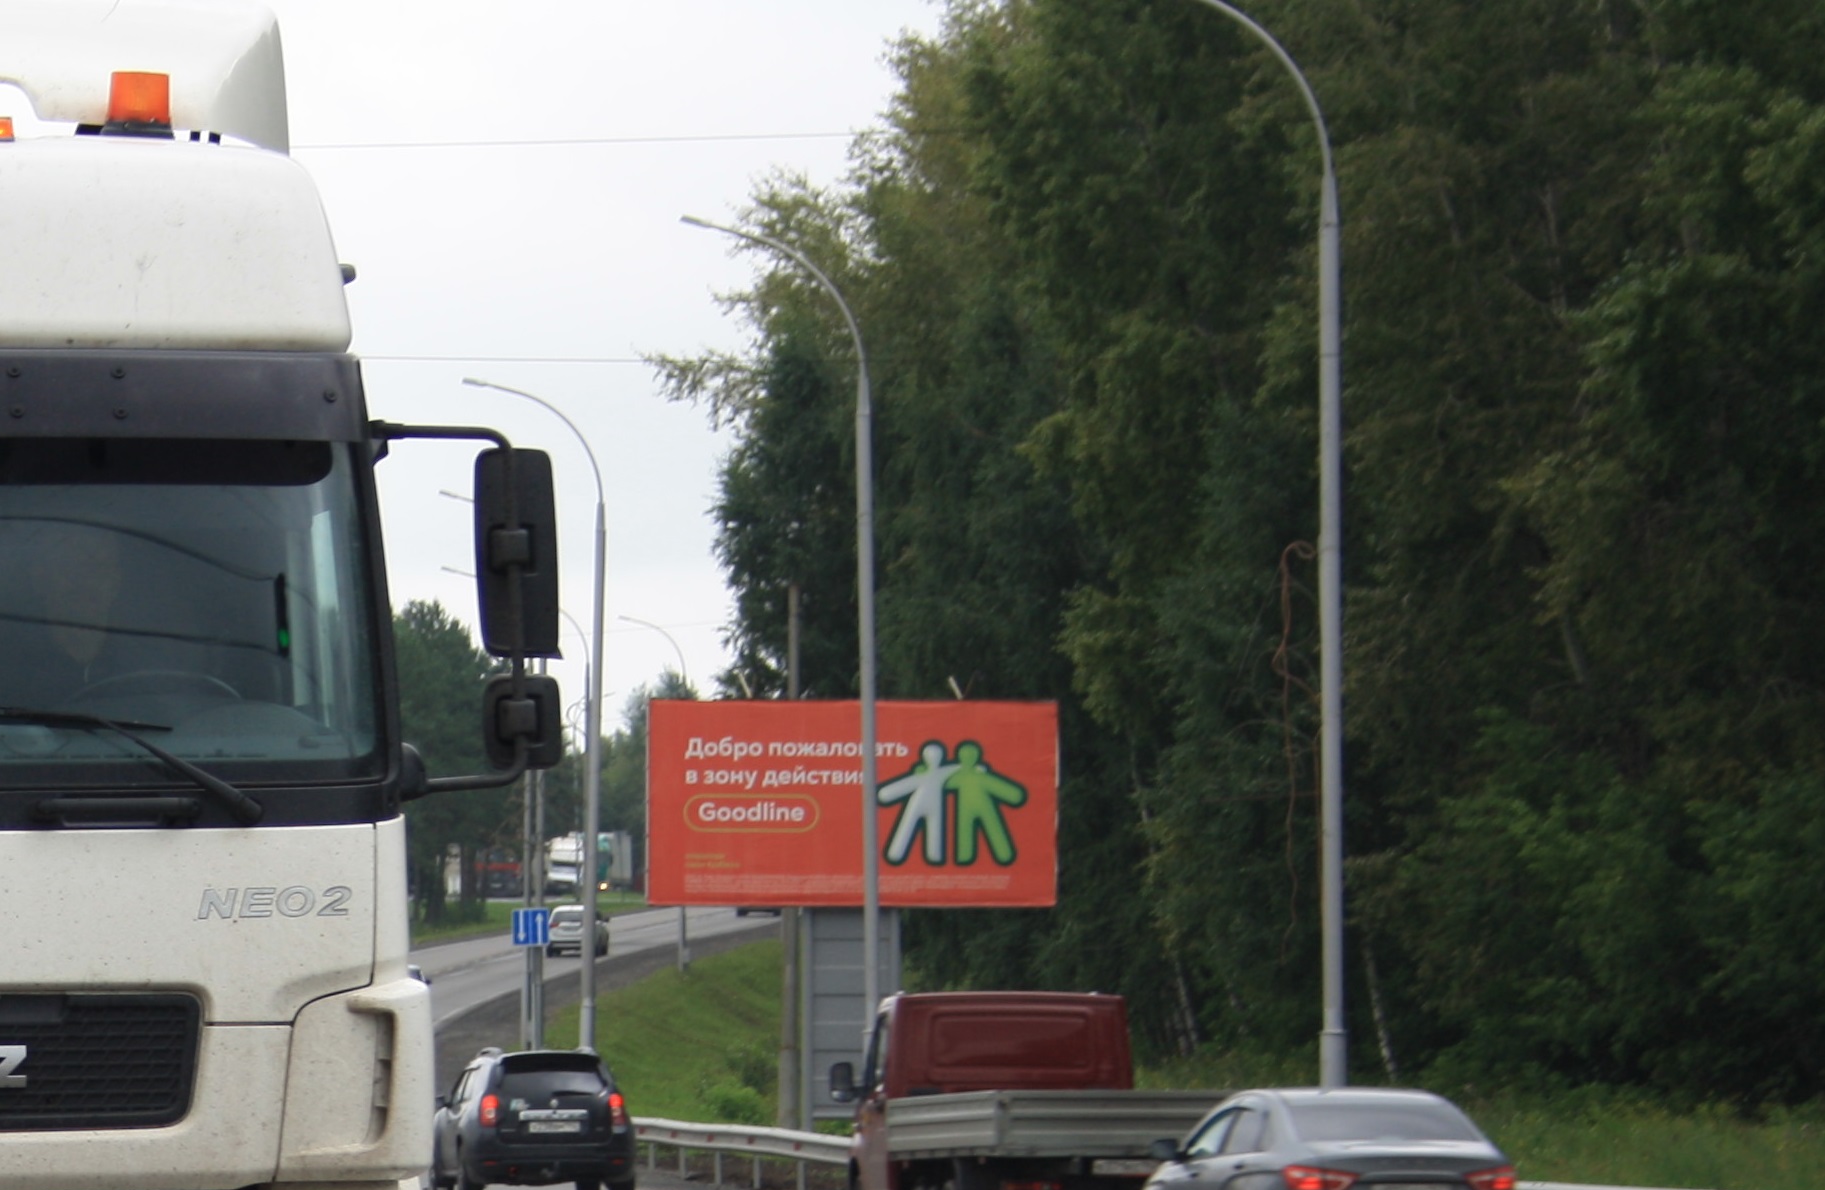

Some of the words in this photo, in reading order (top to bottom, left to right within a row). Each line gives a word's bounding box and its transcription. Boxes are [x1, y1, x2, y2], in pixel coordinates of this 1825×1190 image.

[685, 737, 763, 761] Добро
[685, 770, 698, 785] в
[703, 769, 757, 790] зону
[698, 802, 806, 822] Goodline
[197, 885, 353, 919] NEO2
